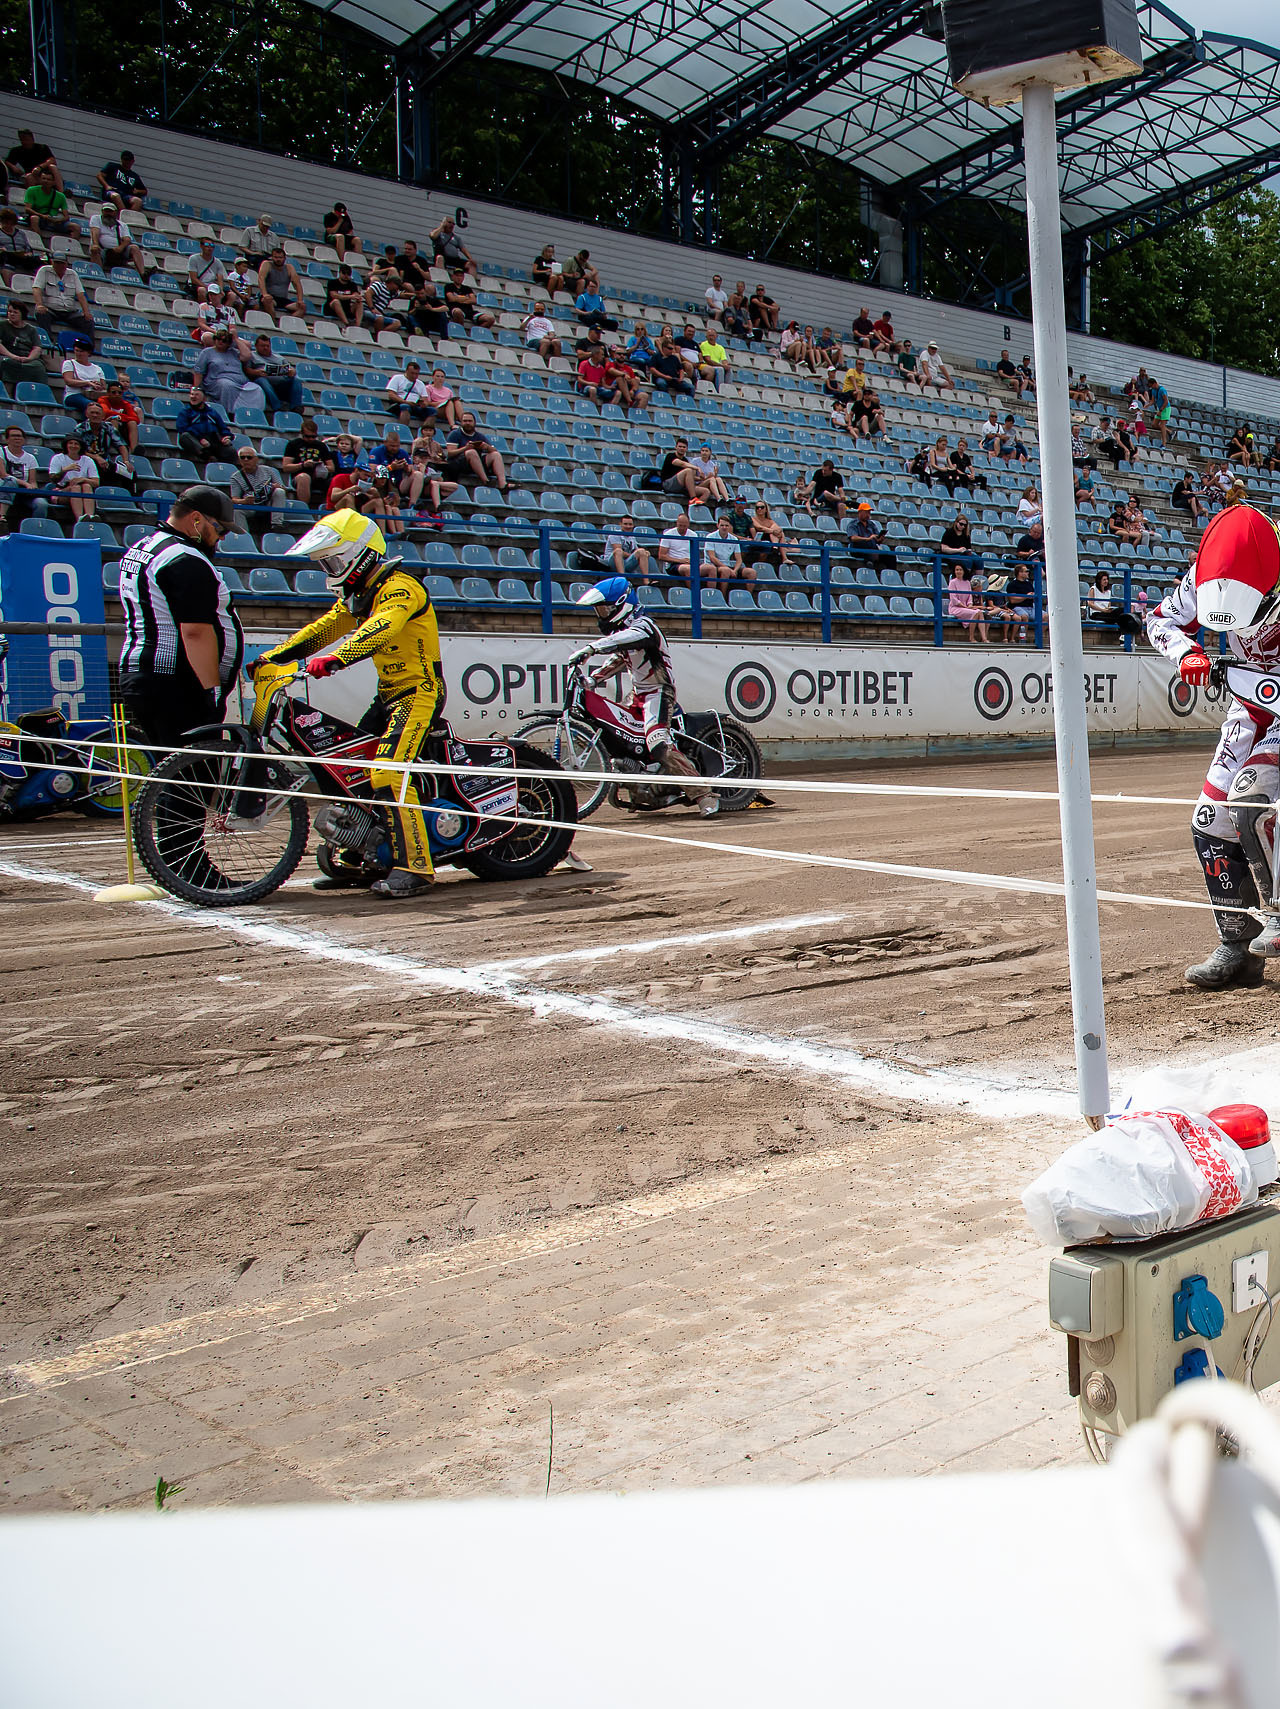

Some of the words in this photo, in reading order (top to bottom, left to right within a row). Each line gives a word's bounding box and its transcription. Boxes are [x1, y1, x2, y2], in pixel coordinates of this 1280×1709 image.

[455, 207, 469, 228] C
[1003, 324, 1011, 341] B
[1209, 614, 1232, 623] SHOEI
[43, 562, 86, 722] RODO
[461, 663, 628, 705] OPTIT
[787, 669, 913, 704] OPTIBET
[787, 709, 859, 717] SPORTA
[872, 707, 913, 717] BĀRS
[491, 748, 508, 757] 23
[481, 794, 512, 814] pamirex
